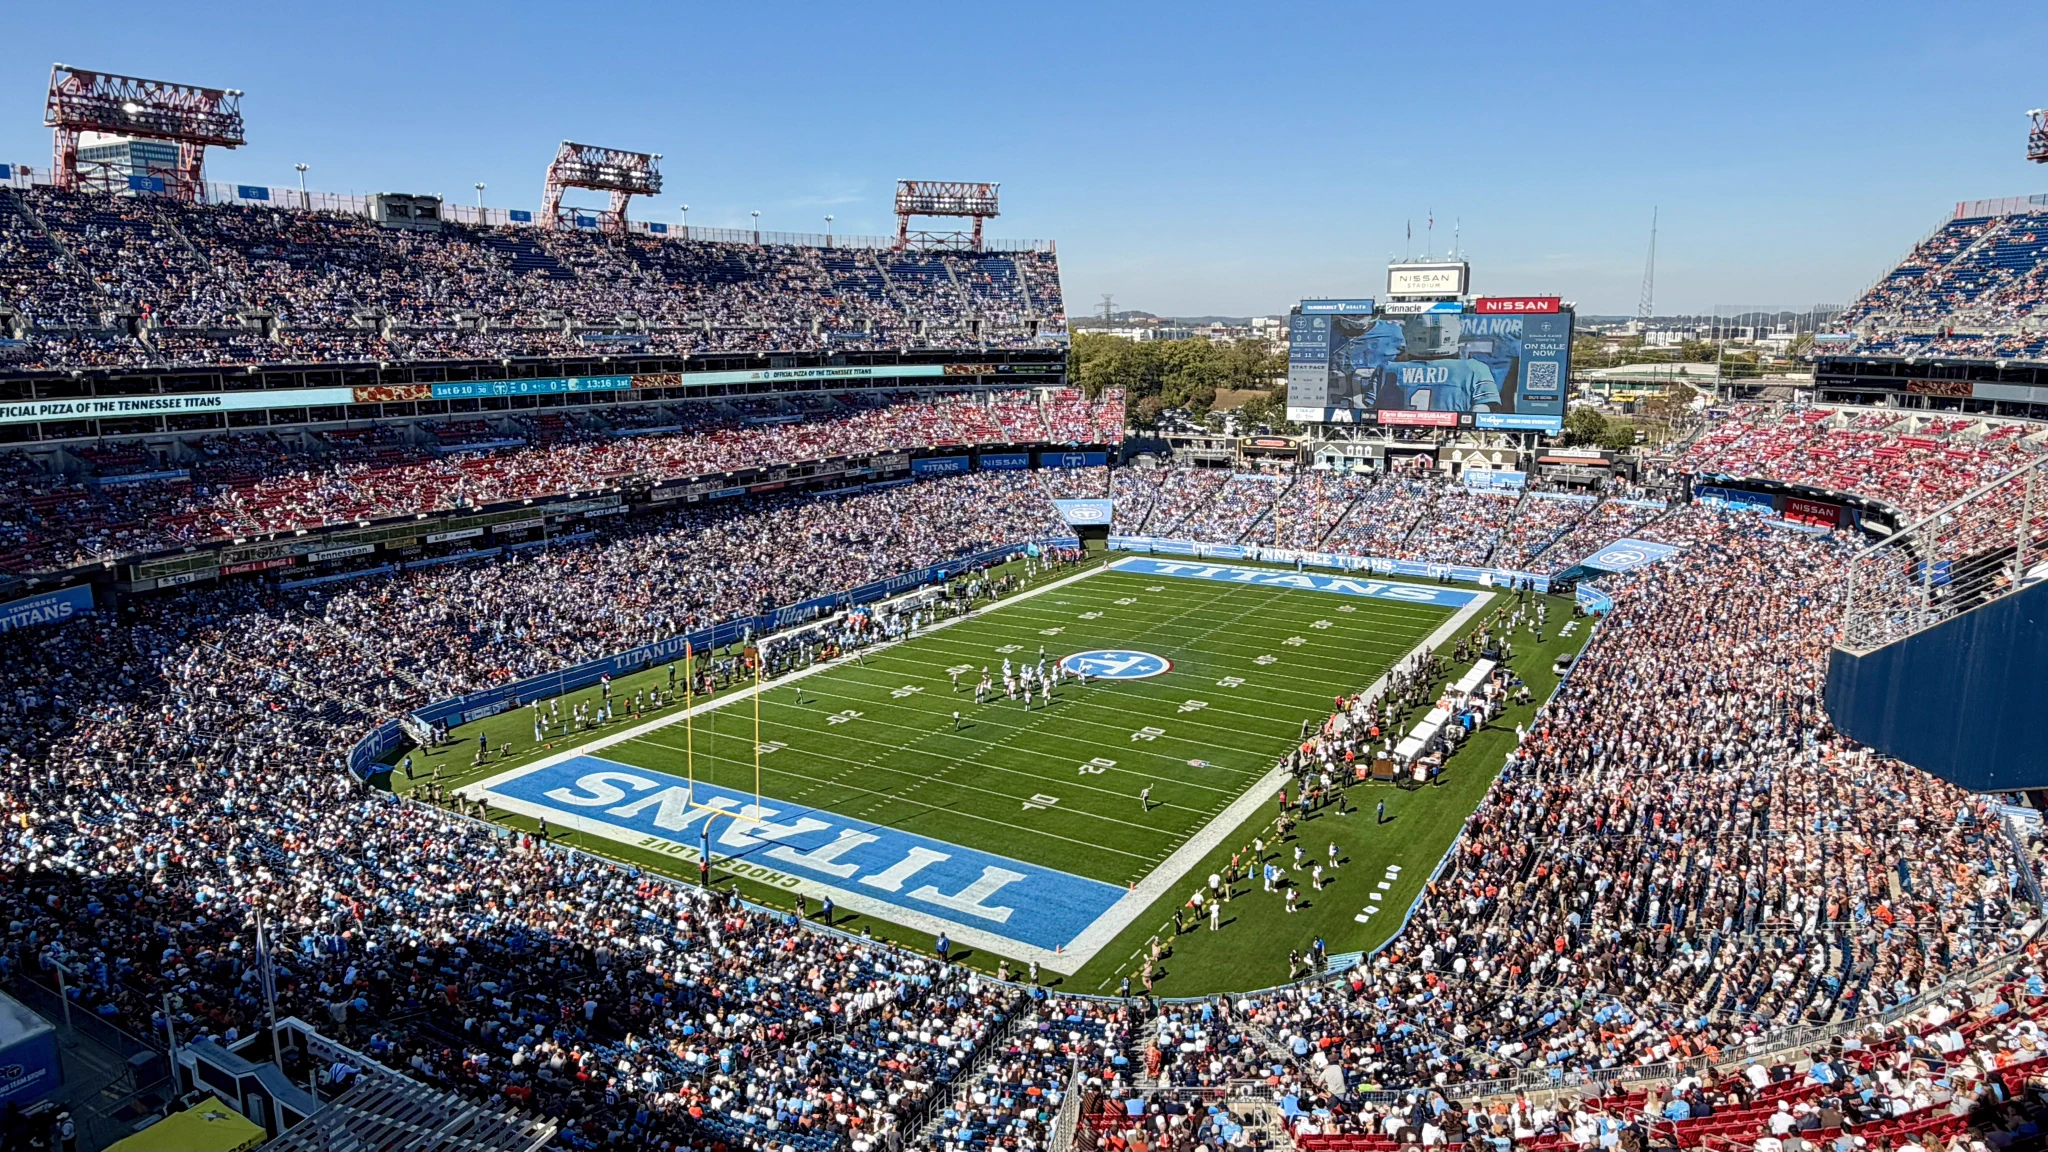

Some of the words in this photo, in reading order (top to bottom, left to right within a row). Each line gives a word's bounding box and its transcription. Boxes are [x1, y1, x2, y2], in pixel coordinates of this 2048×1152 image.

[1400, 274, 1450, 282] NISSAN
[1387, 303, 1422, 313] Pinnacle
[1486, 301, 1548, 310] NISSAN
[1402, 366, 1449, 384] WARD
[437, 387, 451, 395] 1st
[462, 386, 472, 394] 10
[521, 383, 528, 392] 0
[550, 381, 557, 390] 0
[586, 379, 612, 388] 13:16
[40, 403, 74, 415] PIZZA
[76, 402, 91, 413] OF
[93, 401, 115, 412] THE
[118, 398, 182, 411] TENNESSEE
[183, 396, 222, 408] TITANS
[1410, 389, 1431, 411] 1
[922, 462, 958, 472] TITANS
[983, 458, 1026, 467] NISSAN
[584, 510, 603, 518] ROCKY
[605, 507, 618, 515] LAW
[1792, 502, 1834, 516] NISSAN
[315, 547, 368, 560] Tennessean
[885, 575, 917, 592] TITAN
[918, 569, 931, 584] UP
[1155, 562, 1440, 600] TITANS
[9, 597, 58, 614] TENNESSEE
[0, 601, 73, 632] TITANS
[614, 645, 664, 669] TITAN
[669, 638, 688, 657] UP
[1216, 675, 1246, 688] 50
[1177, 699, 1209, 714] 40
[1130, 726, 1166, 742] 30
[1078, 757, 1118, 775] 20
[1022, 793, 1060, 811] 10
[543, 772, 1027, 923] TITANS
[638, 837, 700, 859] LOVE
